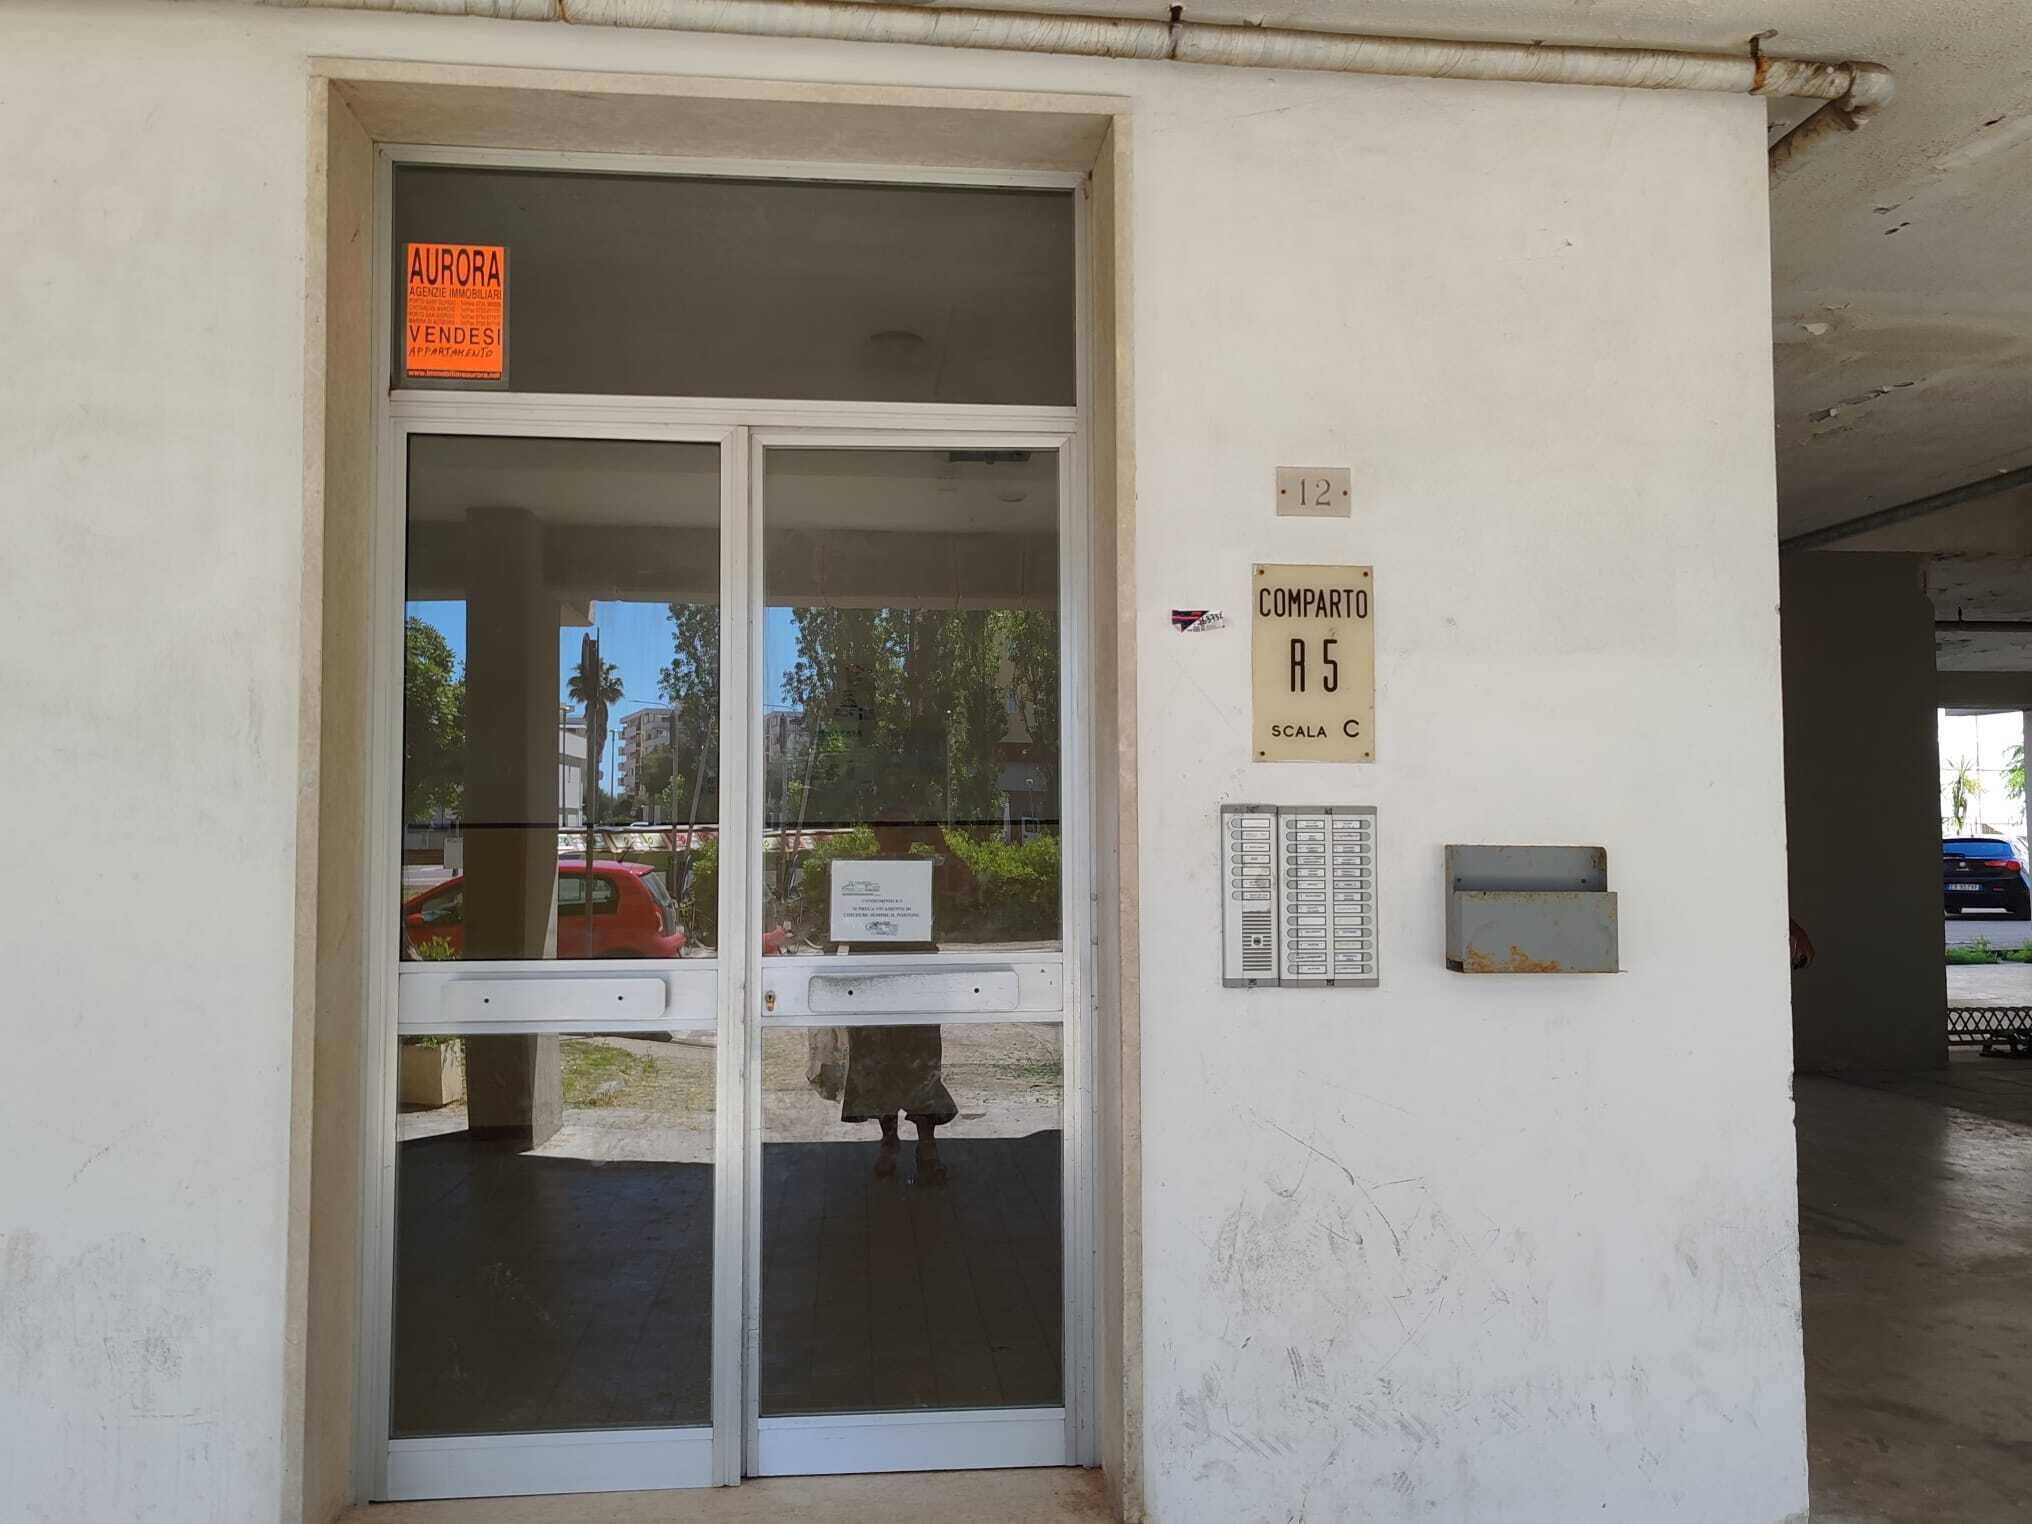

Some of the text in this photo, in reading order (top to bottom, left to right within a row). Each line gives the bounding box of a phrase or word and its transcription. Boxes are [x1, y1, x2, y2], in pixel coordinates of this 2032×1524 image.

[409, 247, 501, 287] AURORA
[409, 286, 502, 300] AGENZIE IMMOBILIARI
[409, 325, 501, 346] VENDESI
[408, 346, 494, 358] APPARTAMENTO
[1299, 478, 1332, 506] 12
[1259, 587, 1368, 619] COMPARTO
[1322, 638, 1338, 693] 5
[1271, 718, 1360, 738] SCALA C
